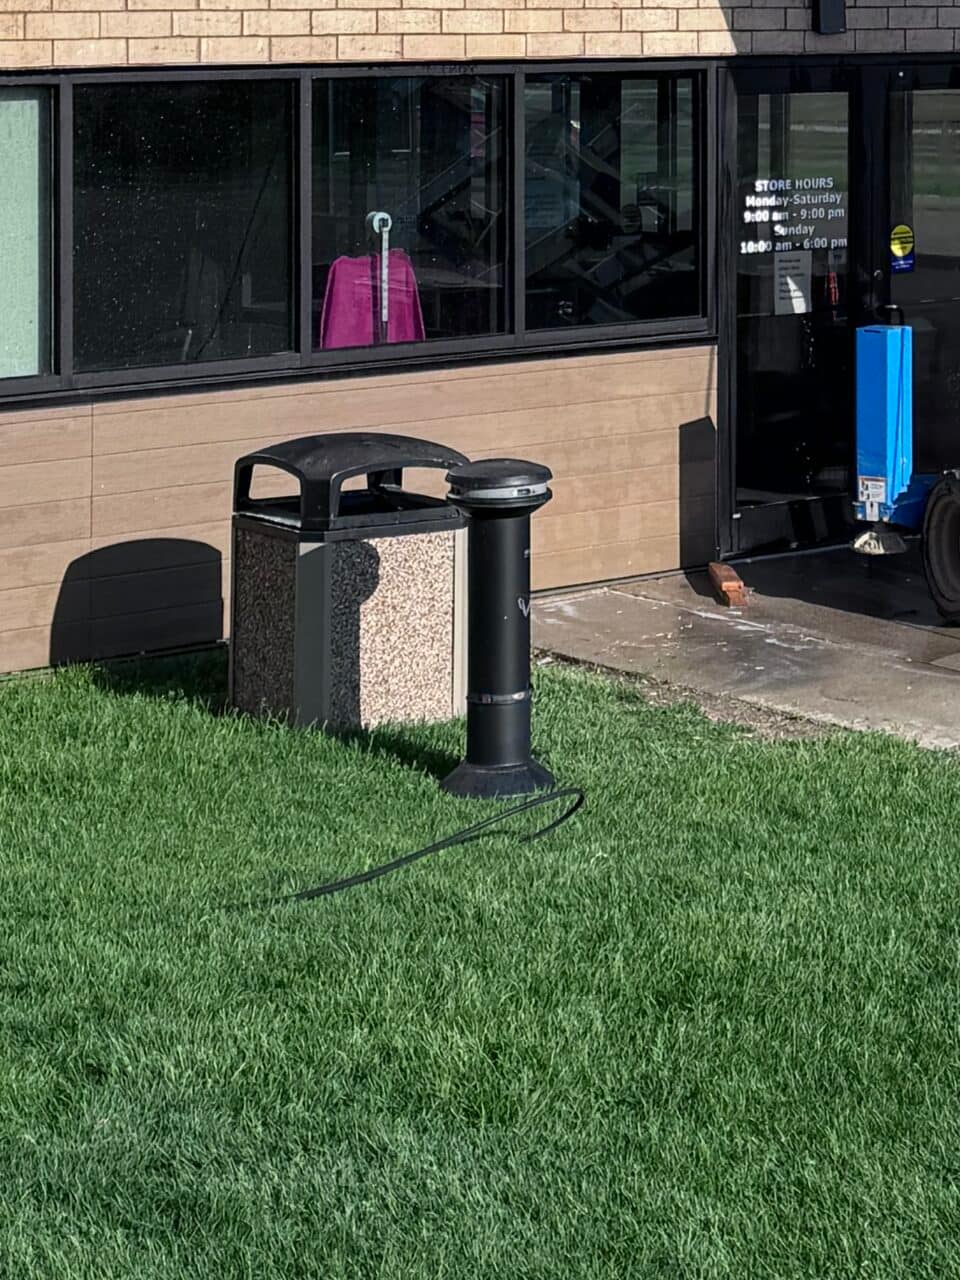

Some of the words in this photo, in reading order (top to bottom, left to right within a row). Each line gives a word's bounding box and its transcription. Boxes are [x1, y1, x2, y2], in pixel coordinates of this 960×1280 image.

[755, 179, 792, 192] STORE
[795, 177, 834, 189] HOURS
[745, 193, 842, 208] Monday-Saturday
[743, 209, 769, 223] 9:00
[772, 211, 789, 221] am
[800, 207, 825, 219] 9:00
[827, 208, 845, 220] pm
[773, 224, 815, 236] Sunday
[740, 239, 772, 254] 10:00
[775, 241, 792, 251] am
[803, 238, 828, 249] 6:00
[831, 238, 848, 249] pm
